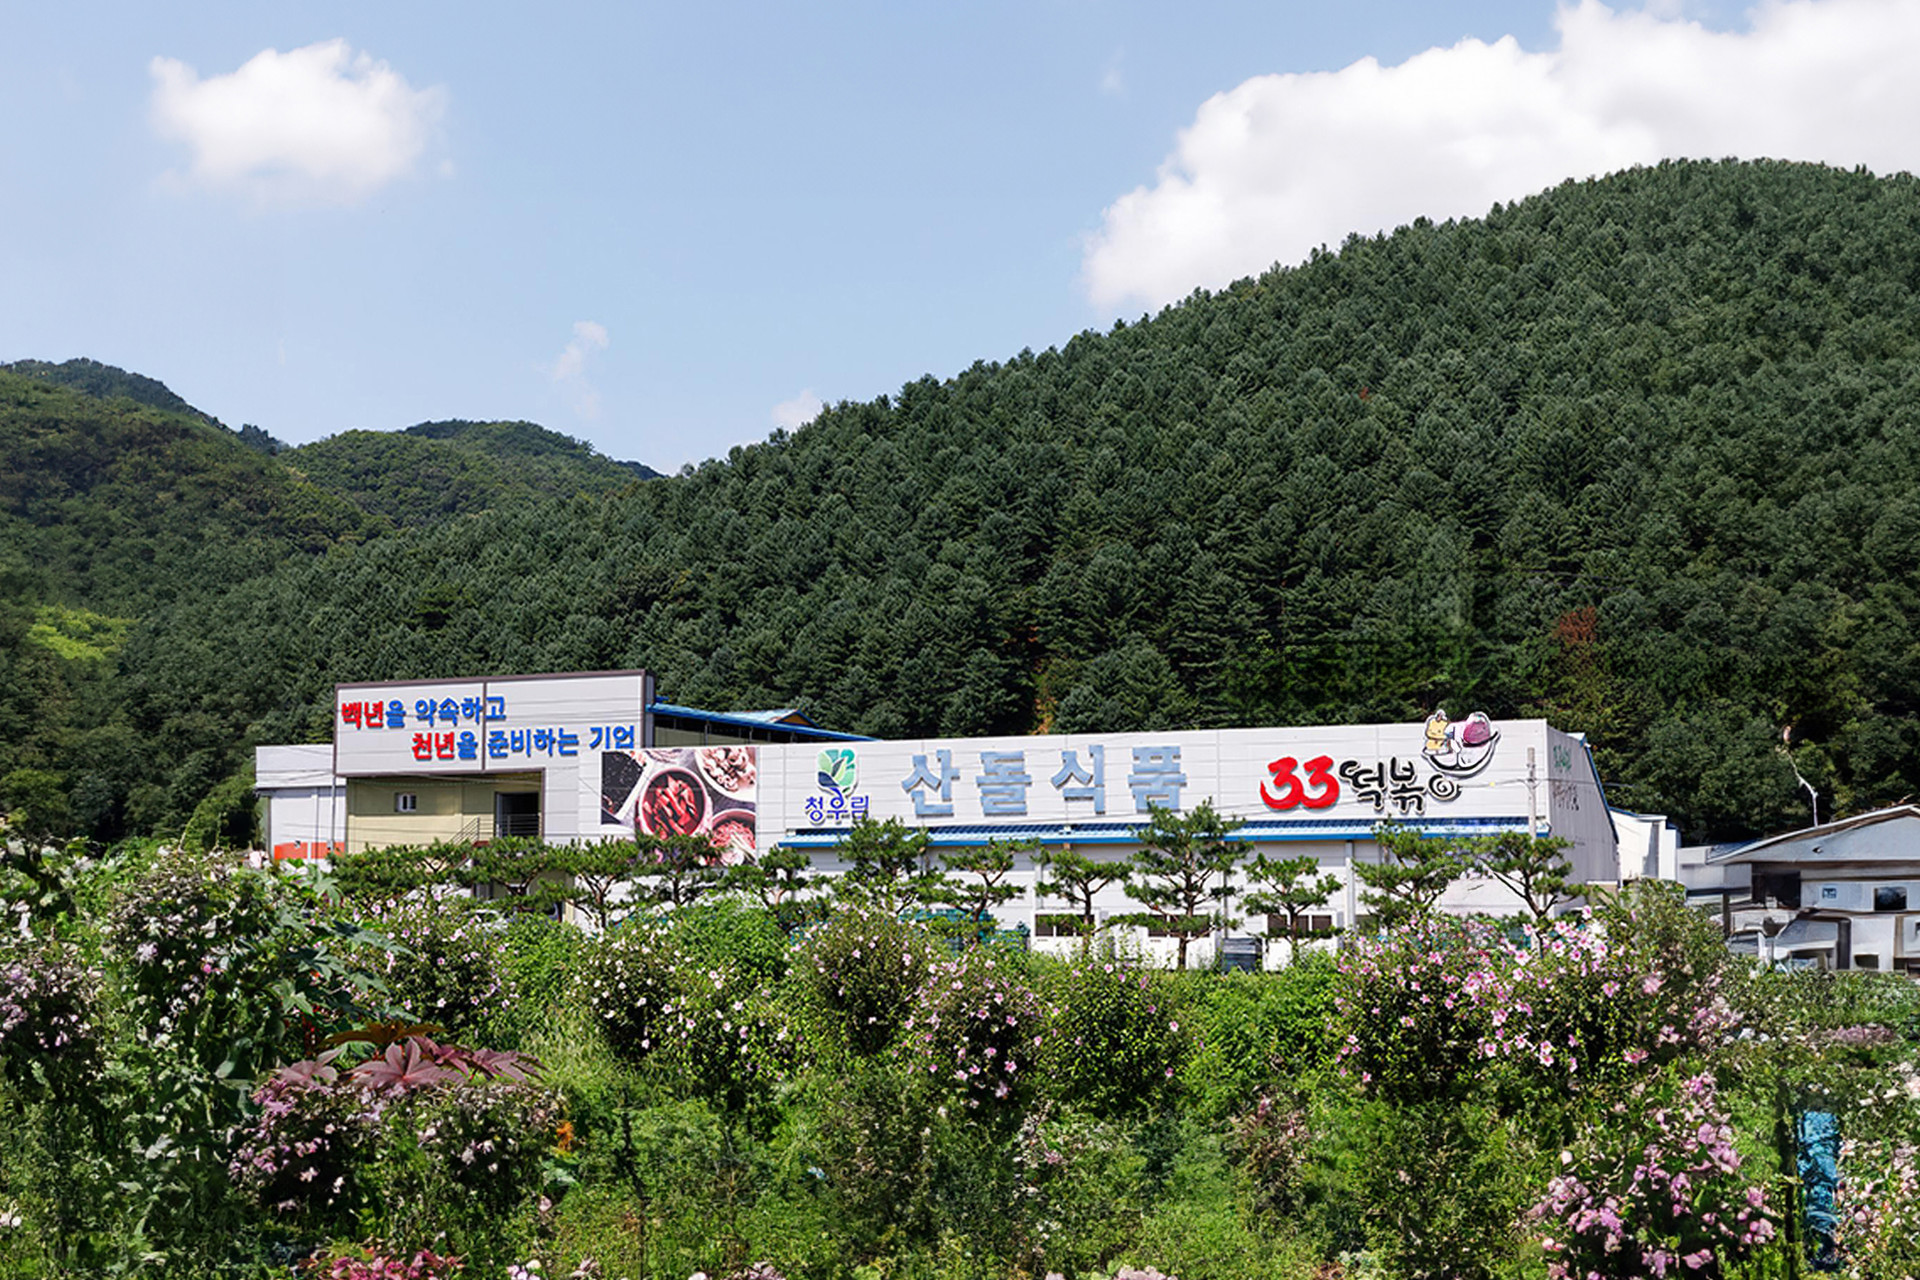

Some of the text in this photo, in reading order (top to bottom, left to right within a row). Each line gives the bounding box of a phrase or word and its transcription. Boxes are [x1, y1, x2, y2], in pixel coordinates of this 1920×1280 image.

[341, 695, 507, 730] 백년을 약속하고
[411, 724, 635, 761] 천년을 준비하는 기업
[900, 744, 1188, 818] 산돌식품
[804, 793, 870, 823] 청우림
